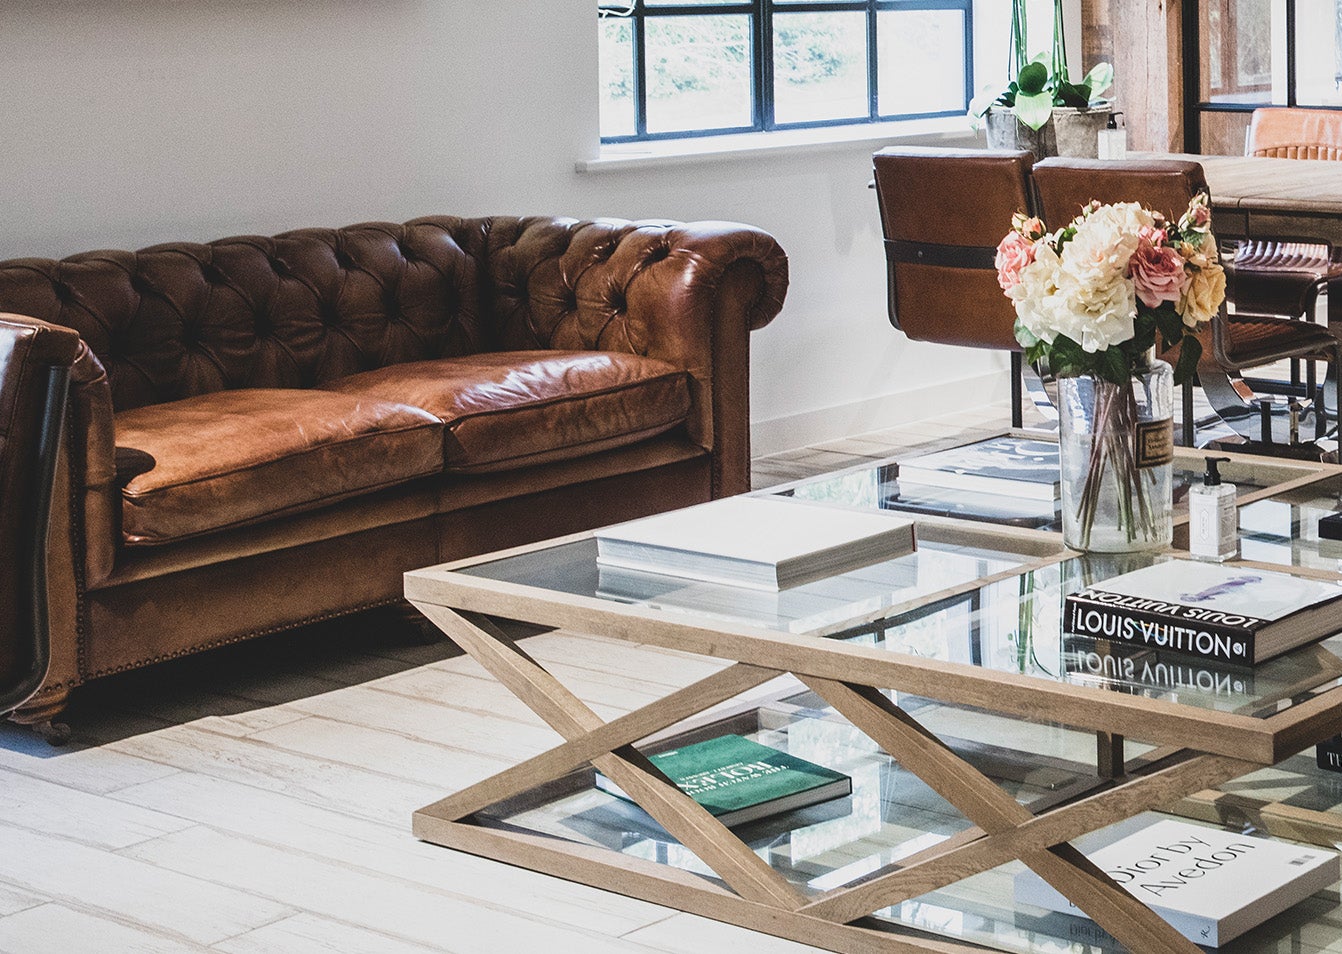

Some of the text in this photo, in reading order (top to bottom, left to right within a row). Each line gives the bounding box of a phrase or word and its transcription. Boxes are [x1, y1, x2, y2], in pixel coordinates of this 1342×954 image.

[1077, 590, 1259, 628] LOUIS VUITTON
[1076, 608, 1135, 640] LOUIS
[1141, 623, 1233, 660] VUITTON
[677, 761, 772, 790] ROLEX
[1156, 835, 1211, 854] by
[1140, 842, 1256, 897] Avedon
